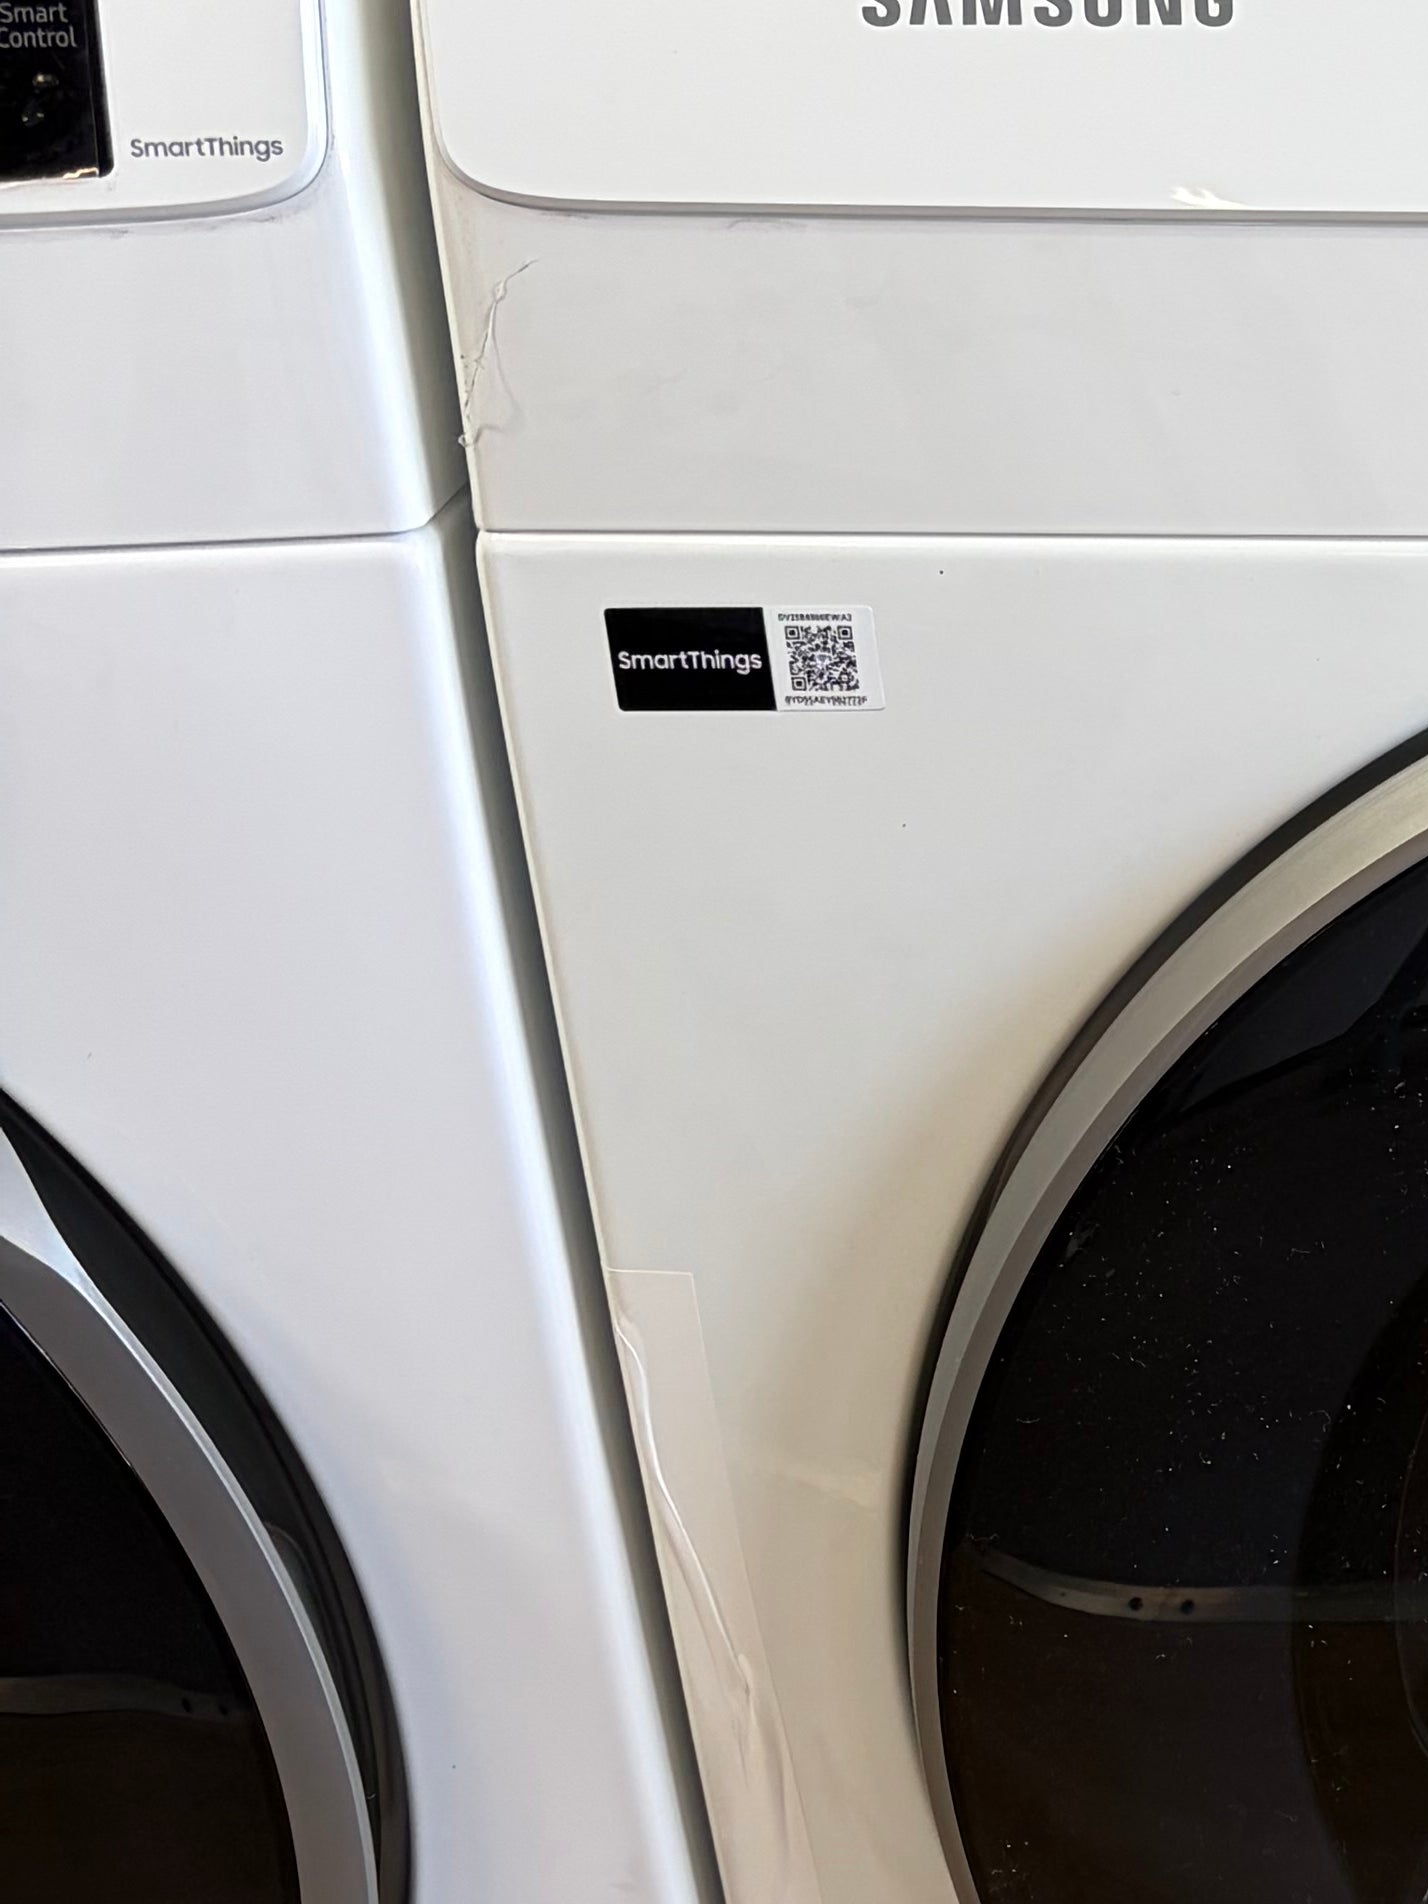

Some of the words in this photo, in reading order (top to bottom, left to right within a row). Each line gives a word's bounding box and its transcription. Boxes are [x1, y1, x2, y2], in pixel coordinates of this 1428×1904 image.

[0, 2, 69, 24] Smart
[0, 25, 78, 49] Control
[130, 135, 284, 162] SmartThings
[617, 649, 763, 676] SmartThings
